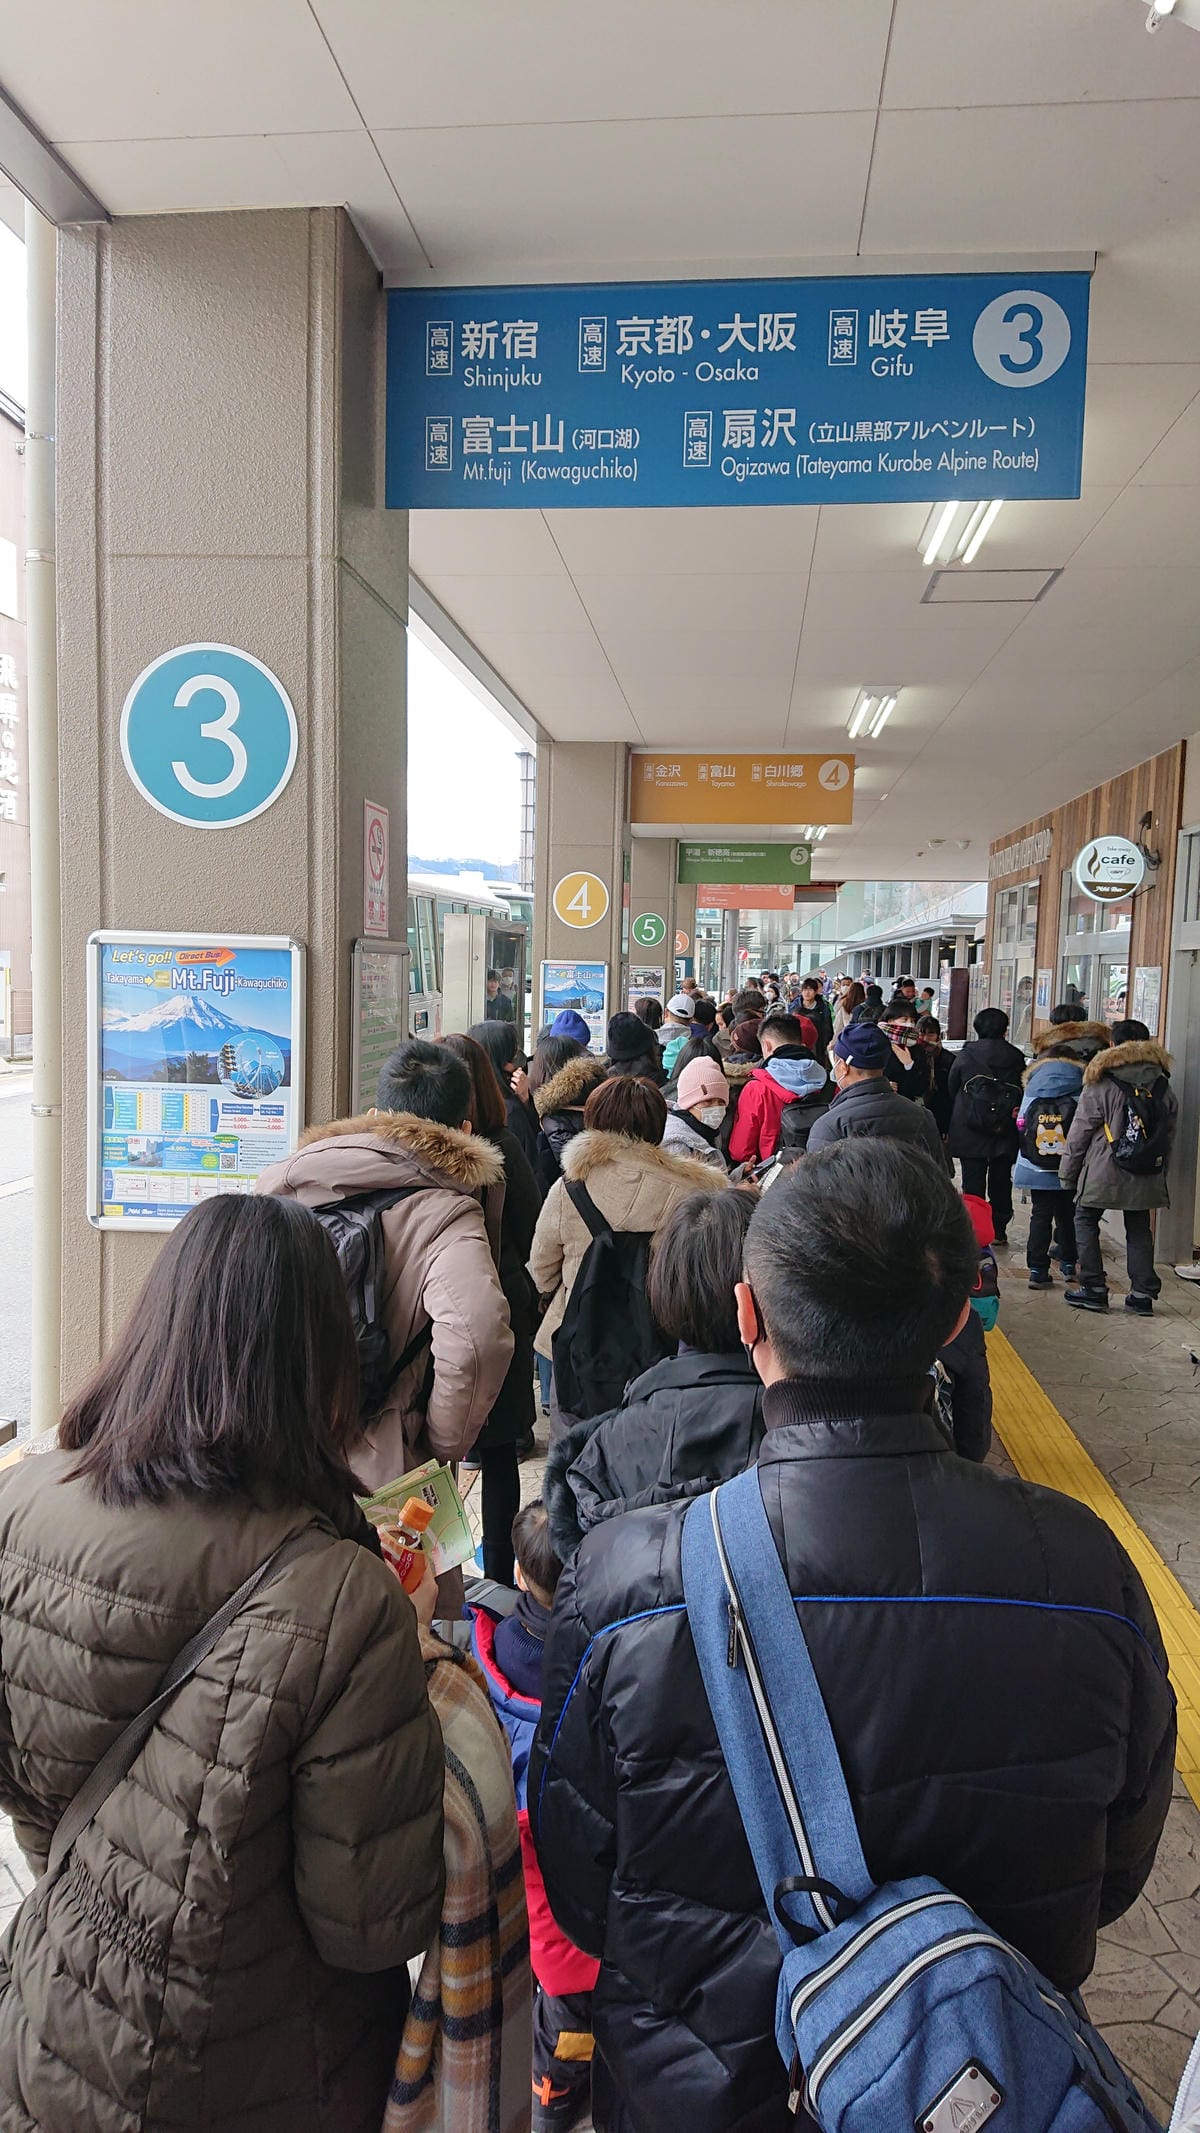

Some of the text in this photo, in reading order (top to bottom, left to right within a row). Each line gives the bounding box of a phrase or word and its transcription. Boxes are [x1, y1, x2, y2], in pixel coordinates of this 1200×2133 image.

[460, 319, 539, 361] 新宿
[582, 323, 603, 366] 高速
[615, 313, 798, 357] 京都・大阪
[833, 316, 853, 360] 高速
[868, 308, 950, 349] 岐阜
[999, 303, 1044, 374] 3
[430, 327, 449, 369] 高速
[463, 364, 542, 392] Shinjuku
[621, 363, 675, 389] Kyoto
[695, 359, 759, 382] Osaka
[871, 354, 914, 377] Gifu
[429, 422, 449, 465] 高速
[461, 413, 565, 454] 富士山
[687, 418, 709, 461] 高速
[722, 408, 1036, 449] 扇沢 （立山黒部アルペンルート）
[463, 457, 638, 486] Mt.fuji (Kawaguchiko)
[721, 447, 1039, 482] Ogizawa (Tateyama Kurobe Alpine Route)
[171, 674, 248, 799] 3
[655, 764, 681, 777] 金沢
[710, 764, 736, 778] 富山
[764, 764, 804, 778] 白川郷
[824, 763, 840, 786] 4
[796, 849, 803, 861] 5
[1101, 854, 1135, 865] cafe
[566, 880, 592, 919] 4
[641, 919, 656, 941] 5
[112, 949, 173, 967] Let's go!!
[738, 949, 745, 961] 7
[106, 972, 144, 986] Takayama
